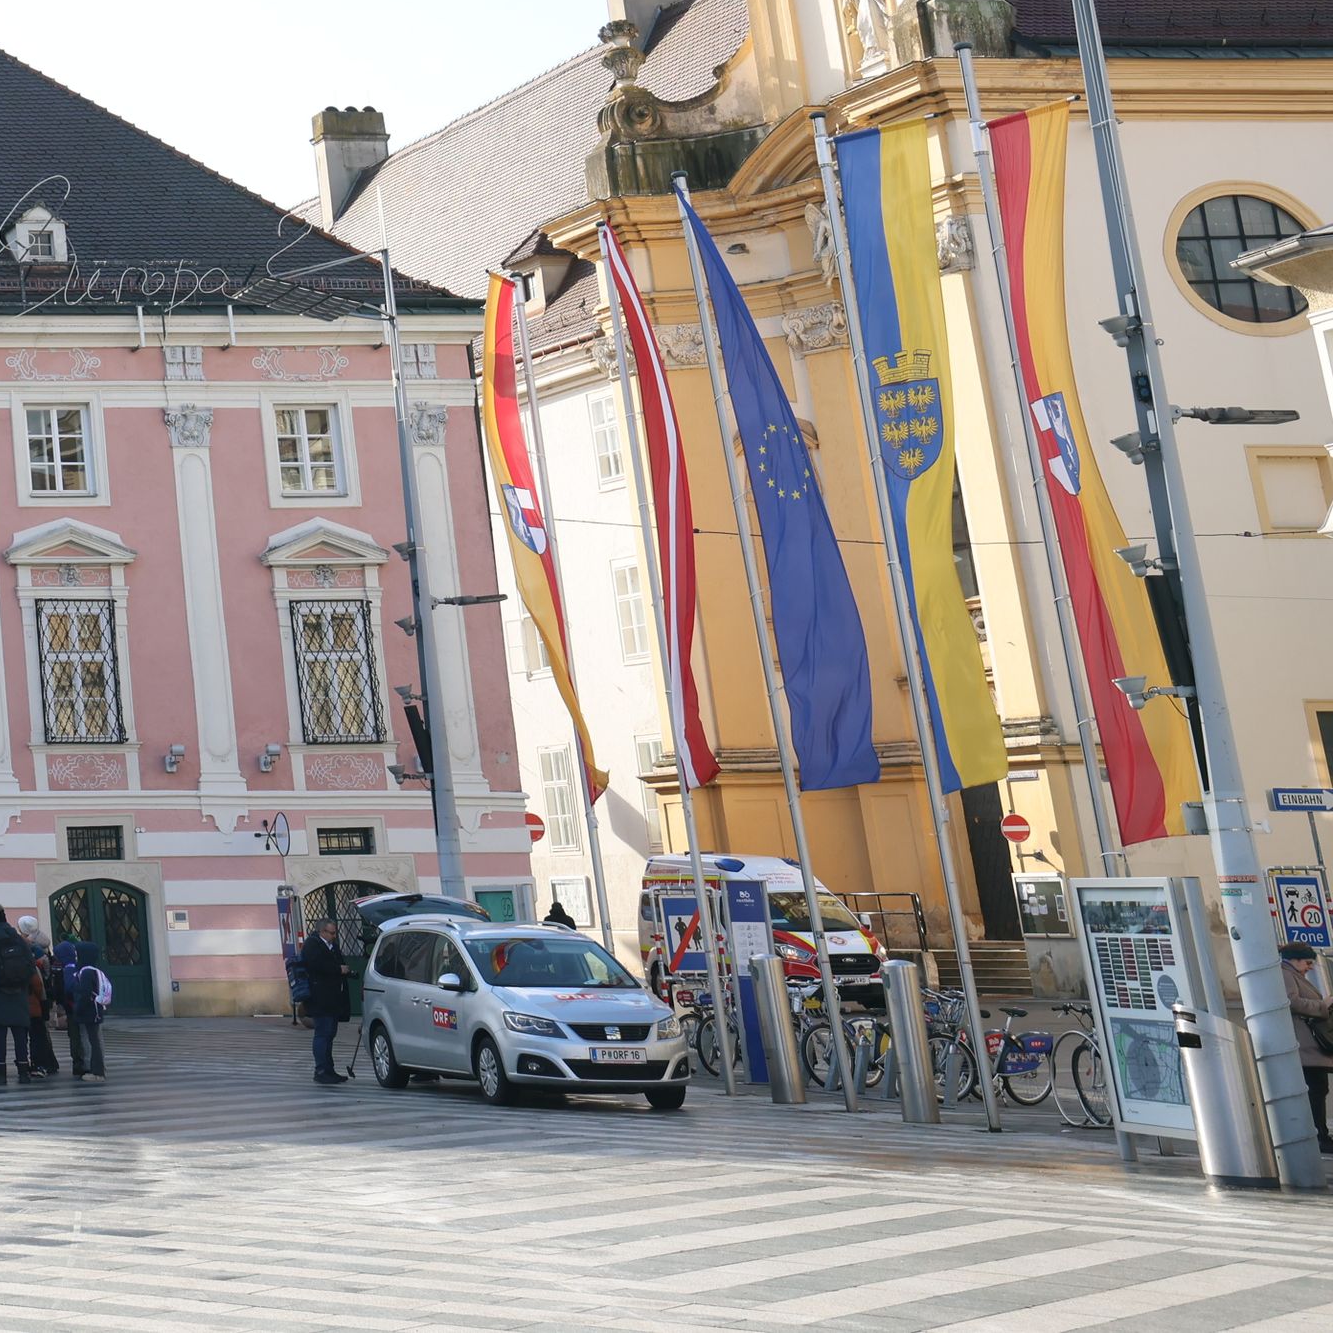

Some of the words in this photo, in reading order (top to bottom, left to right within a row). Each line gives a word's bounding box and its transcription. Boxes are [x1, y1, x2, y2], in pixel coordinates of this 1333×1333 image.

[1282, 794, 1323, 805] EINBAHN
[1307, 912, 1321, 924] 20
[1292, 930, 1324, 943] Zone
[434, 1010, 449, 1024] ORF
[601, 1050, 607, 1060] P
[613, 1050, 629, 1060] ORF
[631, 1050, 640, 1060] 16
